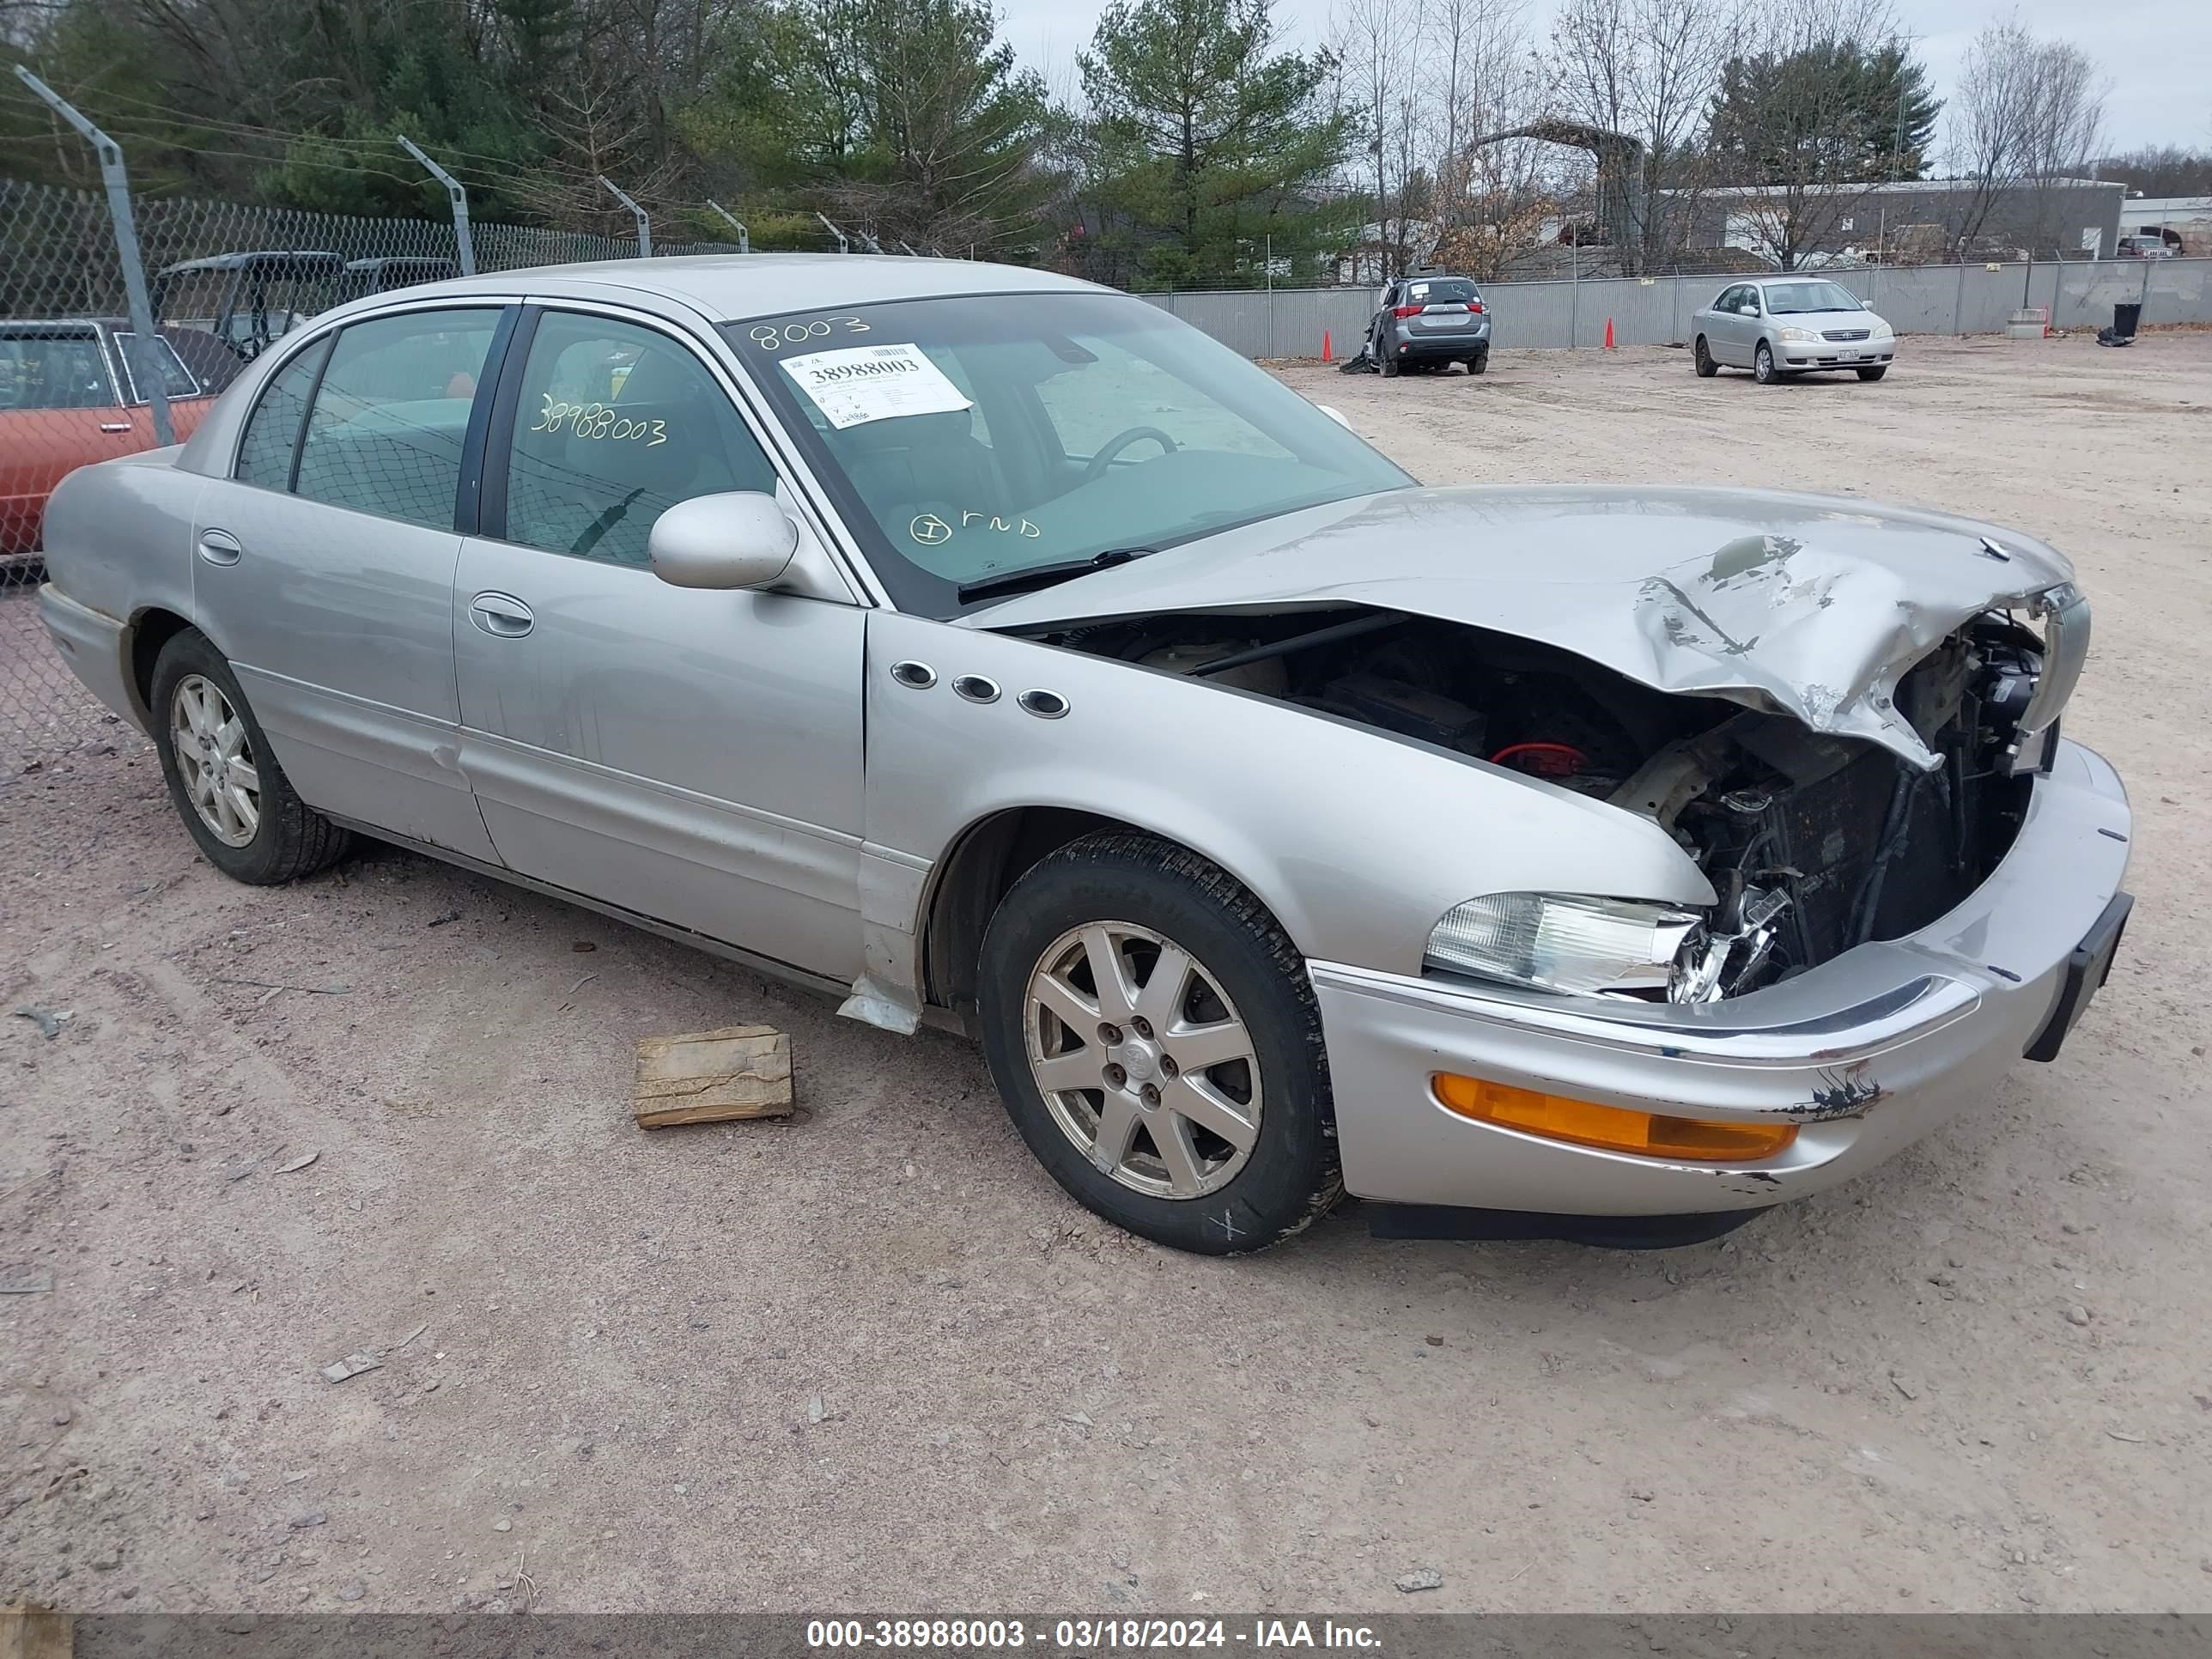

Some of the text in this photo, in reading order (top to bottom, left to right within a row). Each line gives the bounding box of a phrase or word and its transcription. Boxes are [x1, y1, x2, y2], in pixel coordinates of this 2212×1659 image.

[750, 316, 871, 350] 8003
[809, 359, 921, 384] 38988003
[531, 392, 667, 447] 38988003
